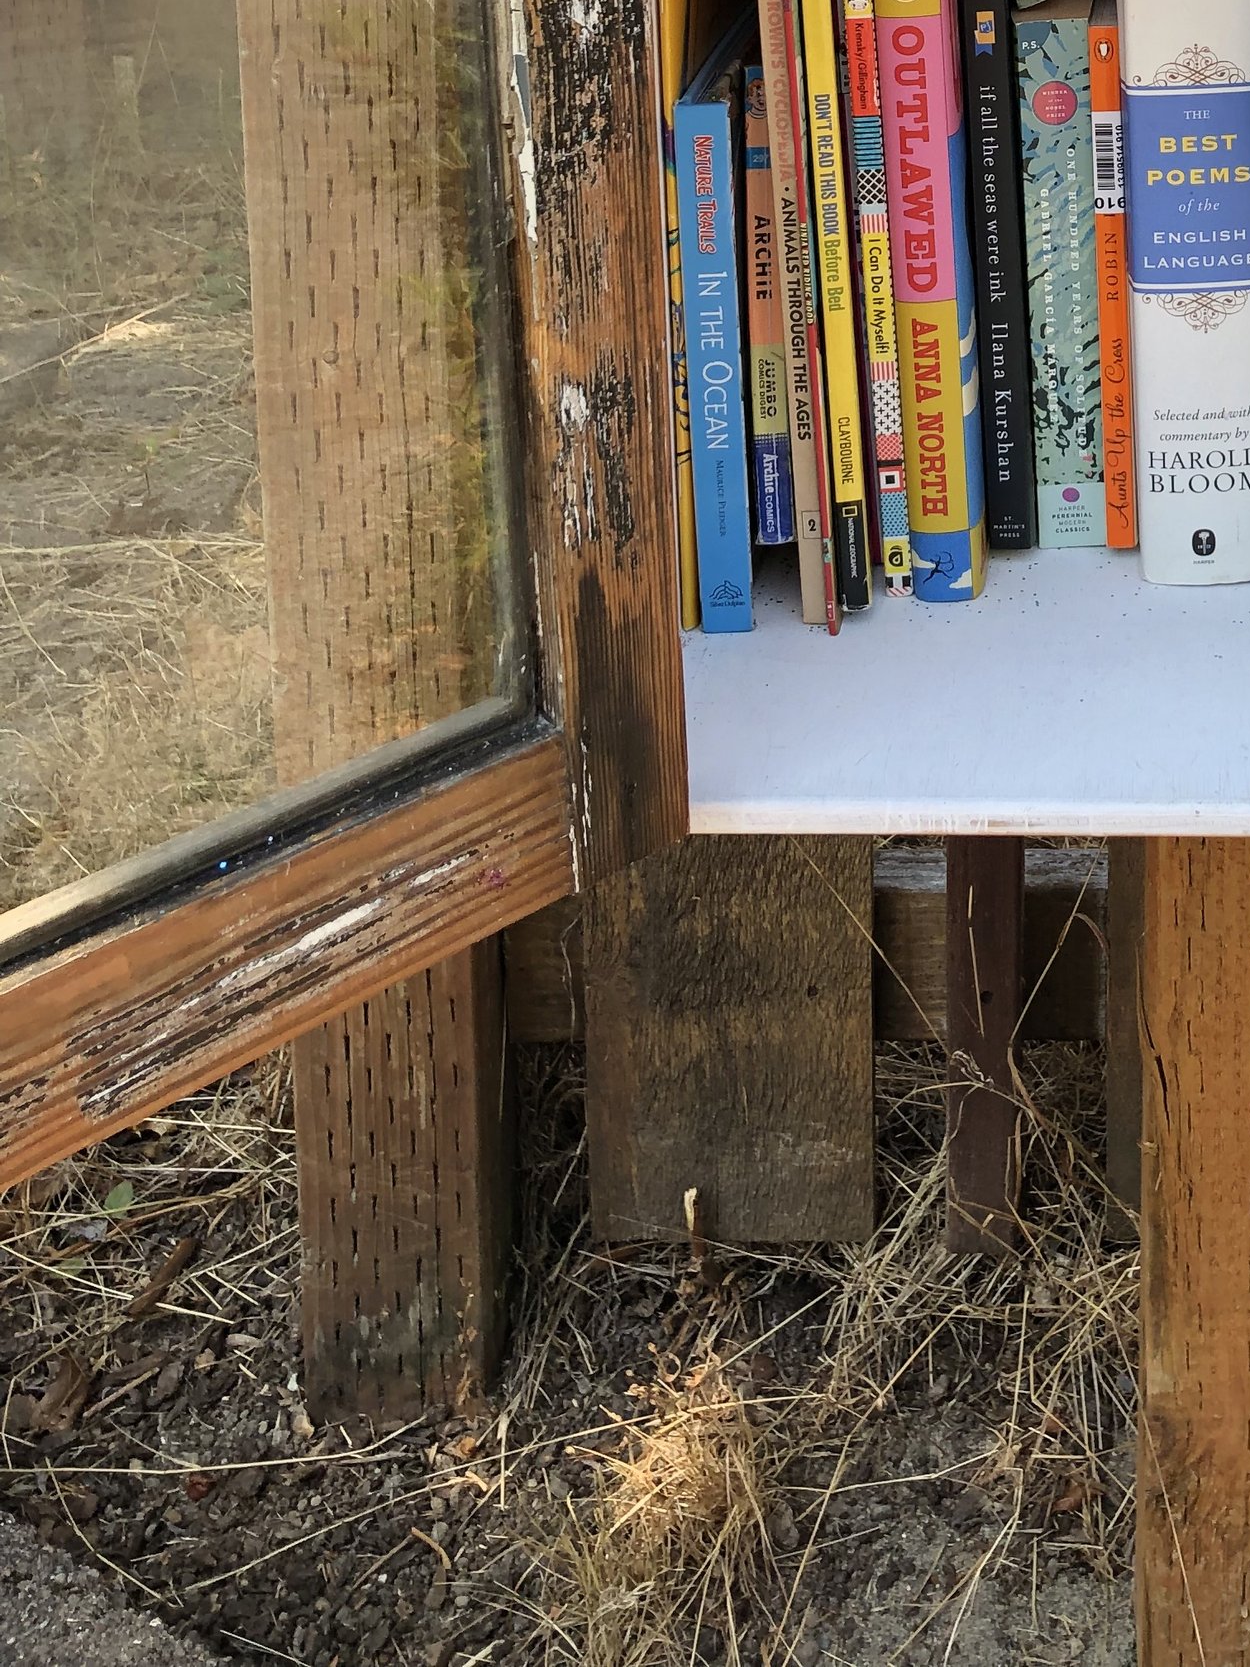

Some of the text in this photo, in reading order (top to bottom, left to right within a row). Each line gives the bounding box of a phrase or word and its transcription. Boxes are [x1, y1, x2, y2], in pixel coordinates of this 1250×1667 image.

[855, 23, 868, 110] Krensky/Gillingham
[1022, 40, 1040, 50] P.S.
[1184, 110, 1210, 120] THE
[1159, 134, 1238, 153] BEST
[694, 135, 716, 254] NATURE TRAILS
[979, 86, 1004, 303] if all the seas were ink
[1146, 166, 1250, 186] POEMS
[813, 94, 845, 311] DON'T READ THIS BOOK Before Bed
[1040, 187, 1052, 263] GABRIEL
[1178, 198, 1220, 215] of the
[781, 197, 799, 274] ANIMALS
[869, 247, 882, 271] Can
[1153, 229, 1247, 244] ENGLISH
[871, 276, 883, 293] Do
[891, 25, 949, 517] OUTLAWED ANNA NORTH
[1106, 232, 1118, 302] ROBIN
[785, 276, 806, 355] THROUGH
[873, 297, 885, 305] It
[1066, 149, 1090, 459] ONE HUNDRED YEARS OF SOLITUDE
[870, 310, 889, 354] Myself!
[698, 271, 733, 451] IN THE OCEAN
[792, 355, 809, 392] THE
[764, 359, 776, 418] JUMBO
[991, 323, 1012, 483] Ilana Kurshan
[795, 397, 812, 441] AGES
[1105, 337, 1132, 529] Aunts Up the Cross
[1154, 409, 1199, 421] Selected
[1203, 408, 1225, 420] and
[1159, 428, 1249, 443] commentary by
[838, 416, 855, 485] CLAYBOURNE
[715, 460, 726, 497] MAURICE
[763, 453, 779, 533] Archie COMICS
[807, 519, 817, 532] 2
